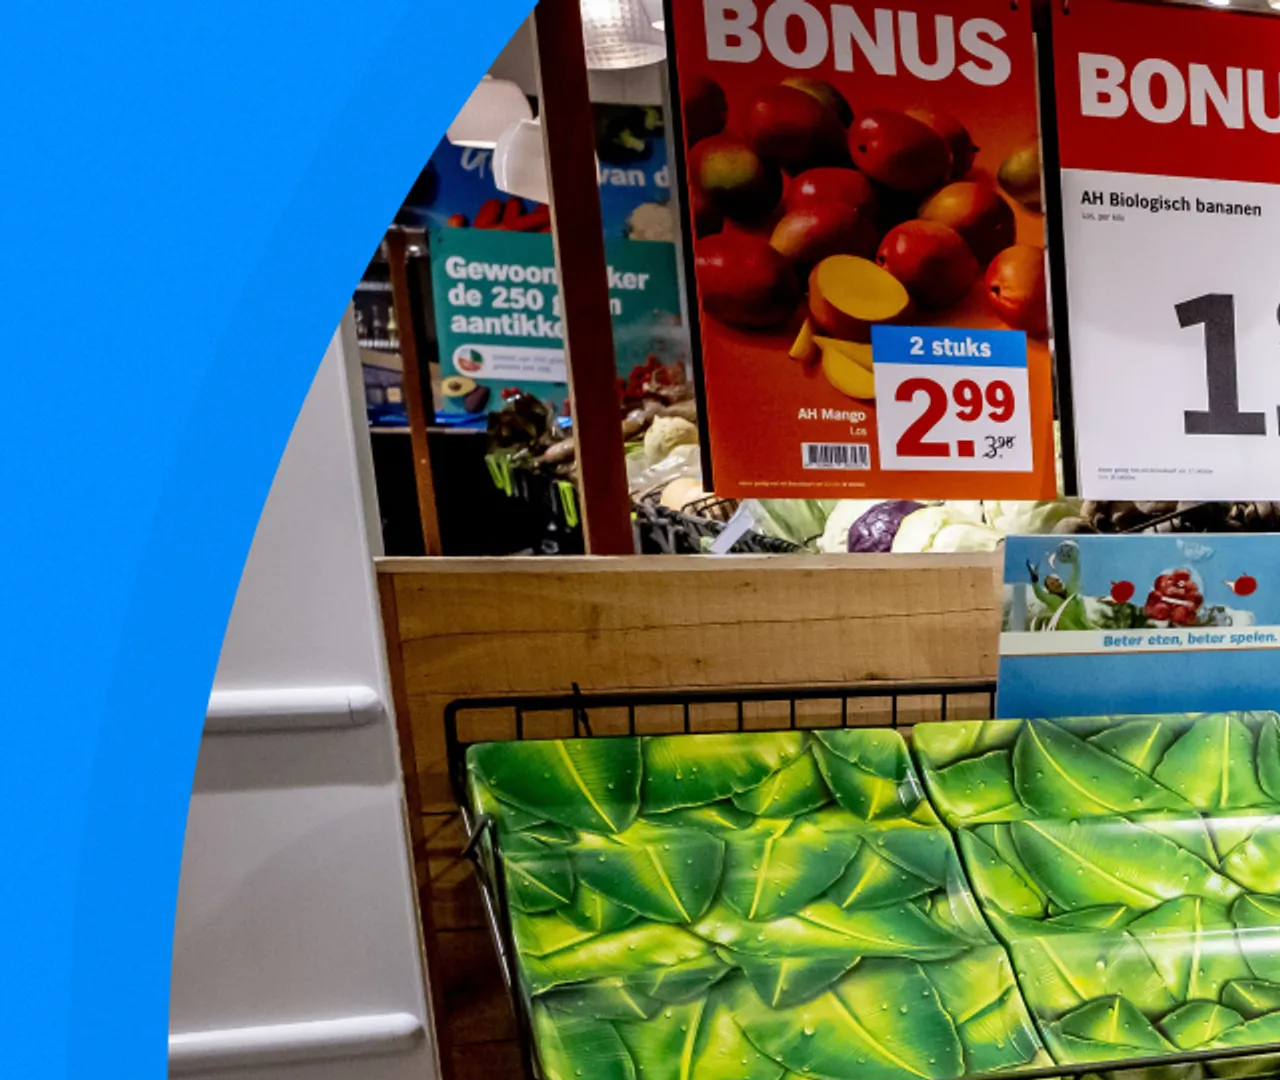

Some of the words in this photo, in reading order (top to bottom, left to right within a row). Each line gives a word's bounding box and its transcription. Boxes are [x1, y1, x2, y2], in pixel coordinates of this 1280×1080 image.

[703, 0, 1011, 86] BONUS
[1081, 191, 1104, 205] AH
[1110, 192, 1191, 213] Biologisch
[1196, 197, 1262, 217] bananen
[445, 256, 559, 284] Gewoon
[448, 284, 482, 306] de
[491, 287, 544, 309] 250
[909, 337, 924, 356] 2
[932, 338, 992, 358] stuks
[798, 408, 818, 420] AH
[821, 408, 866, 424] Mango
[895, 378, 1015, 457] 2.99
[1103, 635, 1143, 647] Beter
[1148, 634, 1183, 646] eten,
[1188, 633, 1225, 645] beter
[1230, 631, 1278, 644] spelen.
